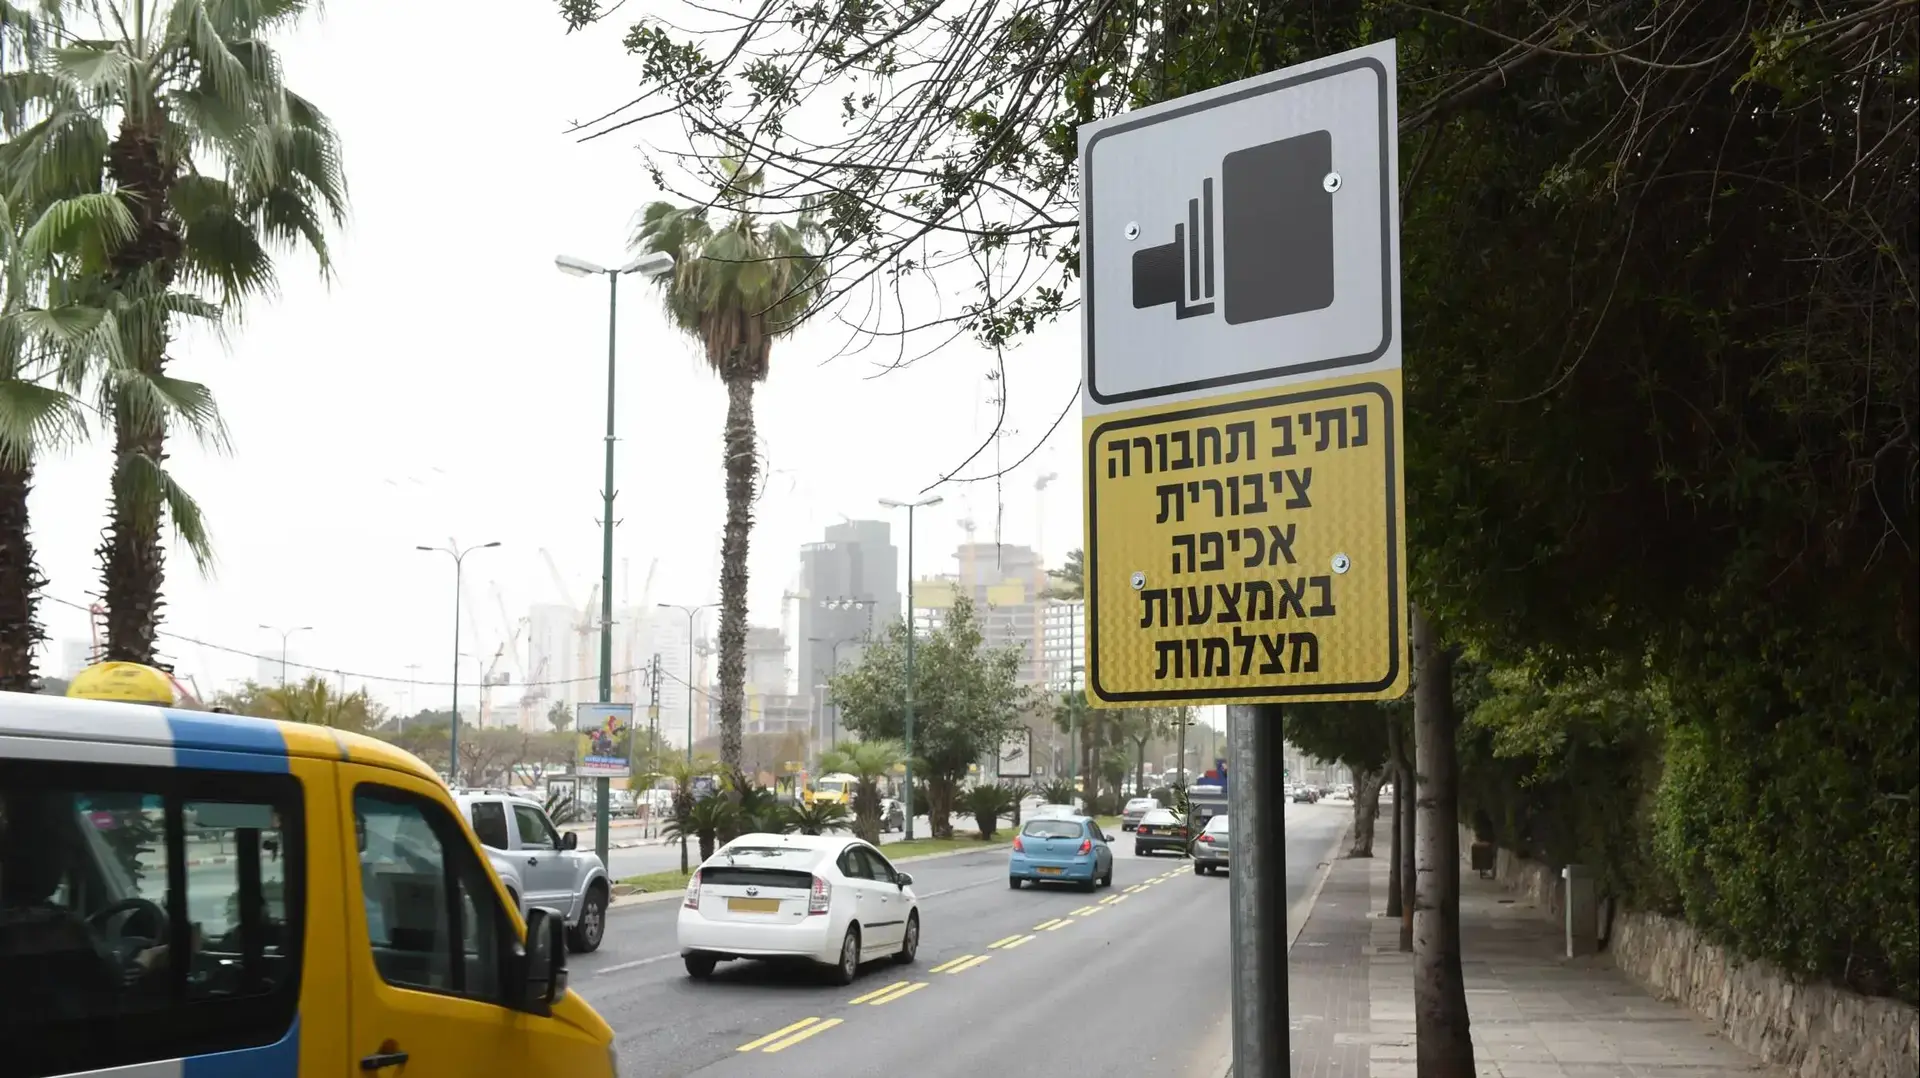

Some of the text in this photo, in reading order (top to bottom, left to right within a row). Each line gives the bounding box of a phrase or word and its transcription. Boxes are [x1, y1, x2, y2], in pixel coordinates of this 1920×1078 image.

[1108, 404, 1368, 479] נתיב תחבורה
[1156, 466, 1313, 524] ציבורית
[1172, 523, 1297, 574] אכיפה
[1140, 575, 1336, 628] באמצעות
[1155, 626, 1318, 679] מצלמות
